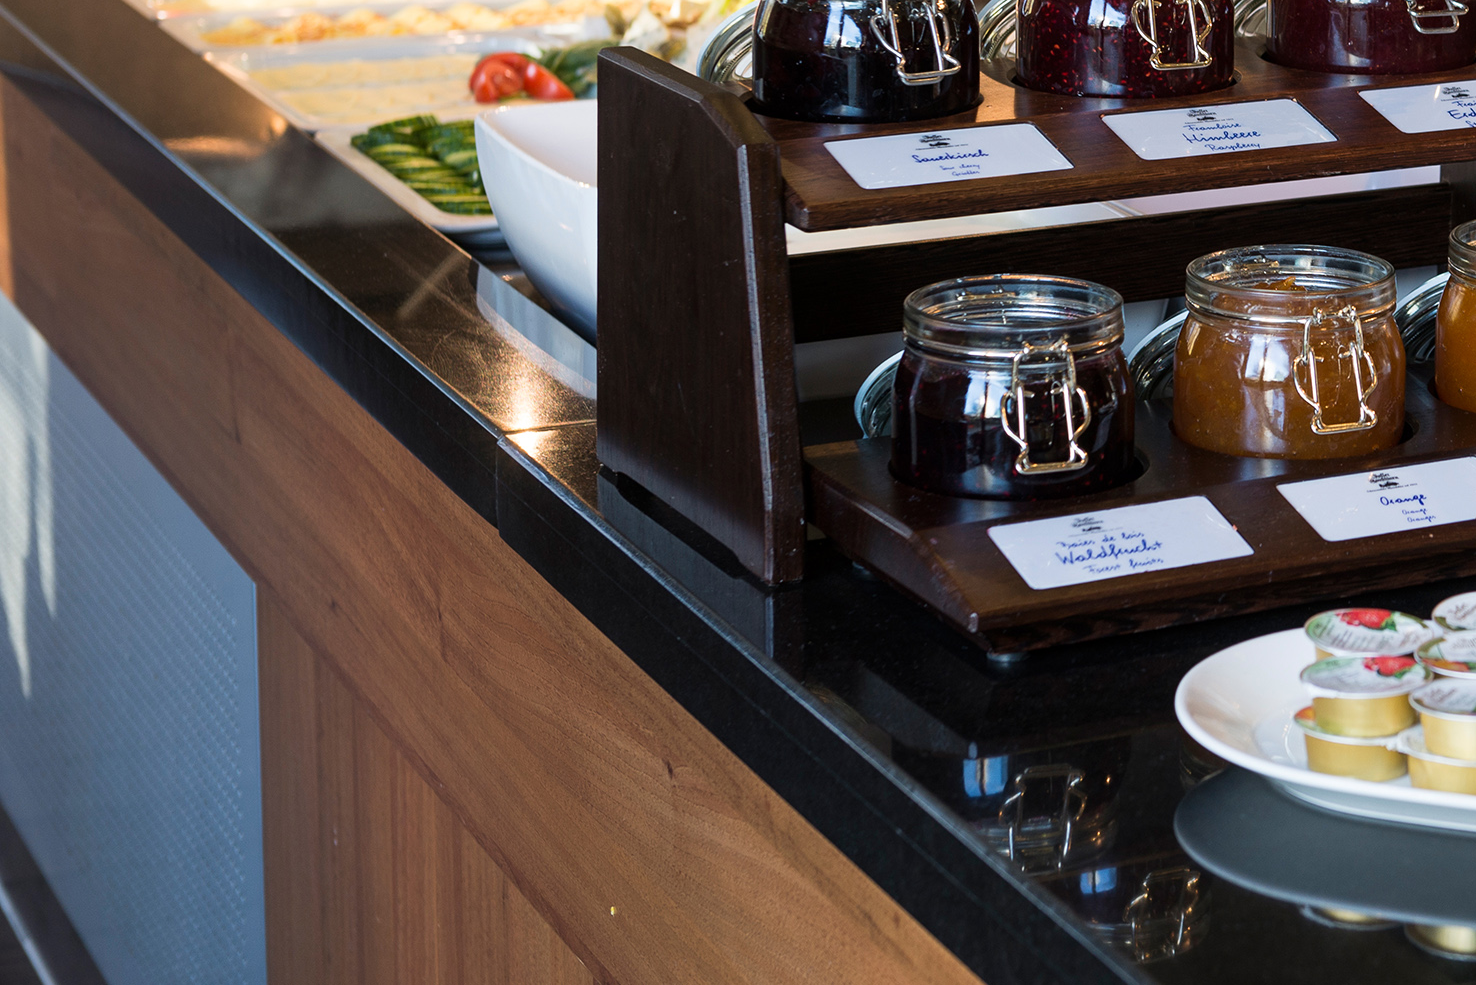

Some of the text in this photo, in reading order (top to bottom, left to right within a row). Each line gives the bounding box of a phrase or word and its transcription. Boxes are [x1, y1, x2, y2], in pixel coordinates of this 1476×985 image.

[1183, 122, 1242, 132] Framboise
[1182, 130, 1262, 144] Himbeere
[1204, 141, 1260, 152] Raspberry
[911, 149, 990, 164] Sauerkirsch
[1379, 492, 1427, 507] Orange
[1054, 538, 1163, 565] Waldfrucht
